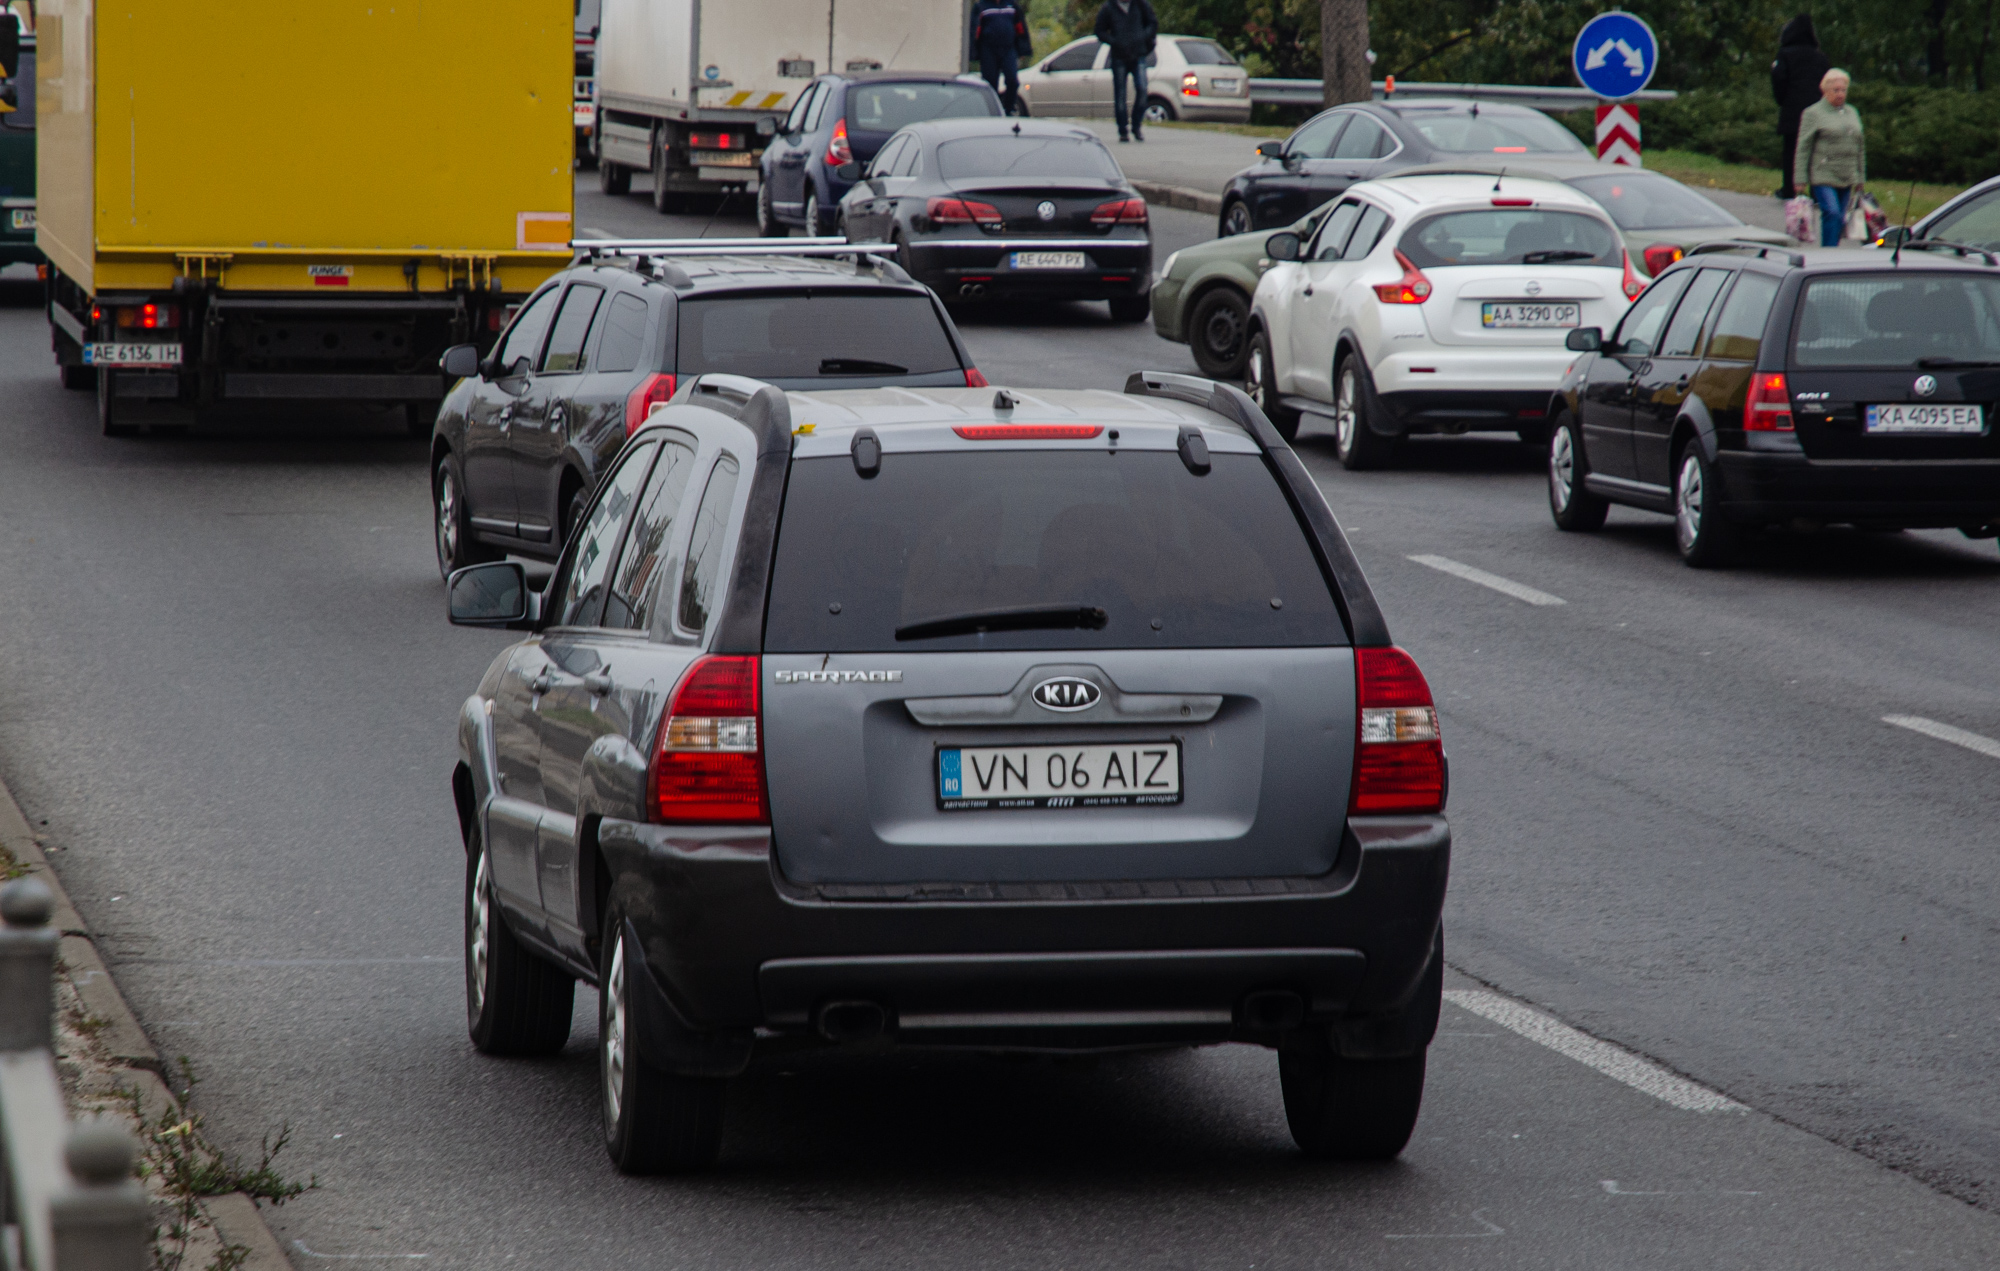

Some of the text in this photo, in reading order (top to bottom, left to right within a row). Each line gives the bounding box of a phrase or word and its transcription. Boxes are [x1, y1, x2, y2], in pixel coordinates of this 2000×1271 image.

[1020, 254, 1035, 265] AE
[1494, 306, 1575, 321] AA 3290 OP
[94, 345, 178, 360] AE 6136 IH
[1879, 408, 1979, 424] KA 4095 EA
[775, 670, 903, 684] SPORTAGE
[1043, 684, 1090, 705] KIA
[971, 751, 1170, 791] VN 06 AIZ
[945, 778, 959, 792] RO
